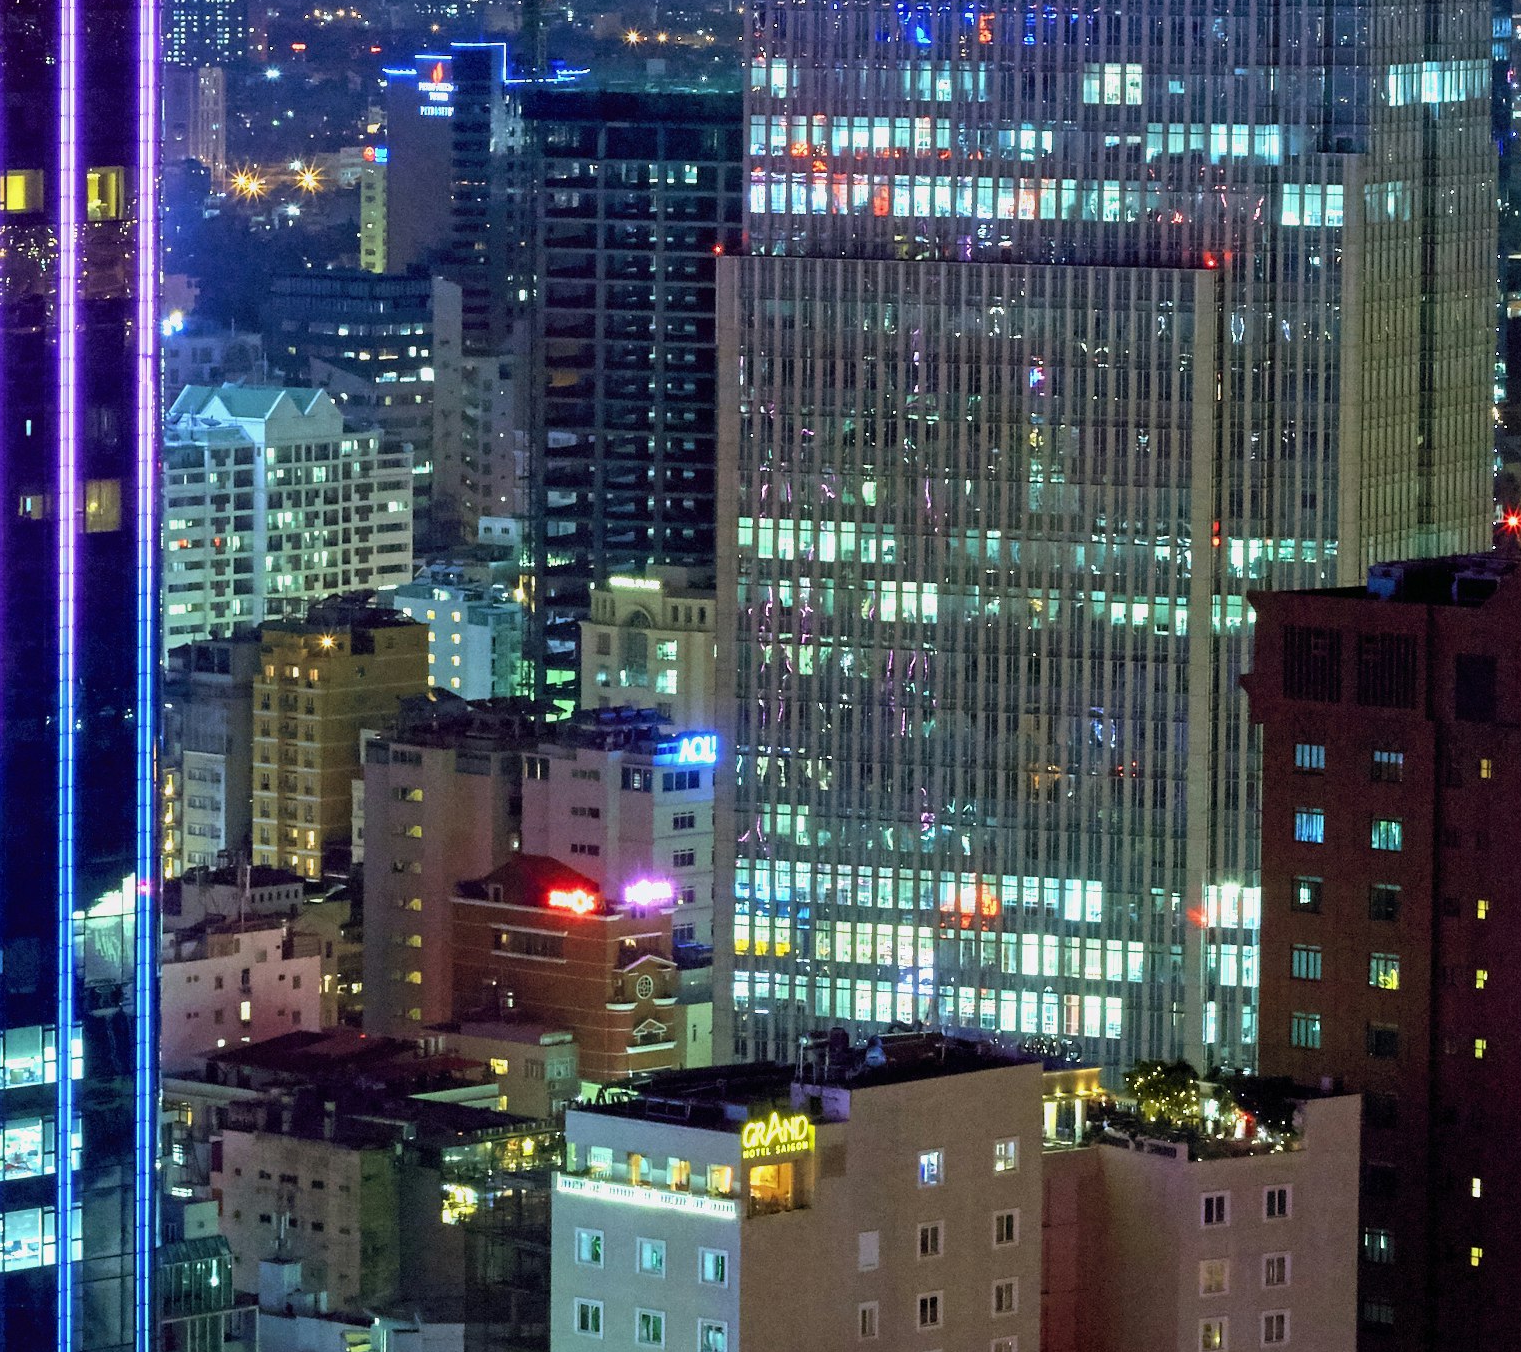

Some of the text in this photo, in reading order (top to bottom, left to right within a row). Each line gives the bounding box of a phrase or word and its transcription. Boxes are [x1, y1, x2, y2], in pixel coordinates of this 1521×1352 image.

[742, 1112, 808, 1148] GRAND
[743, 1141, 809, 1159] HOTEL SAIGON
